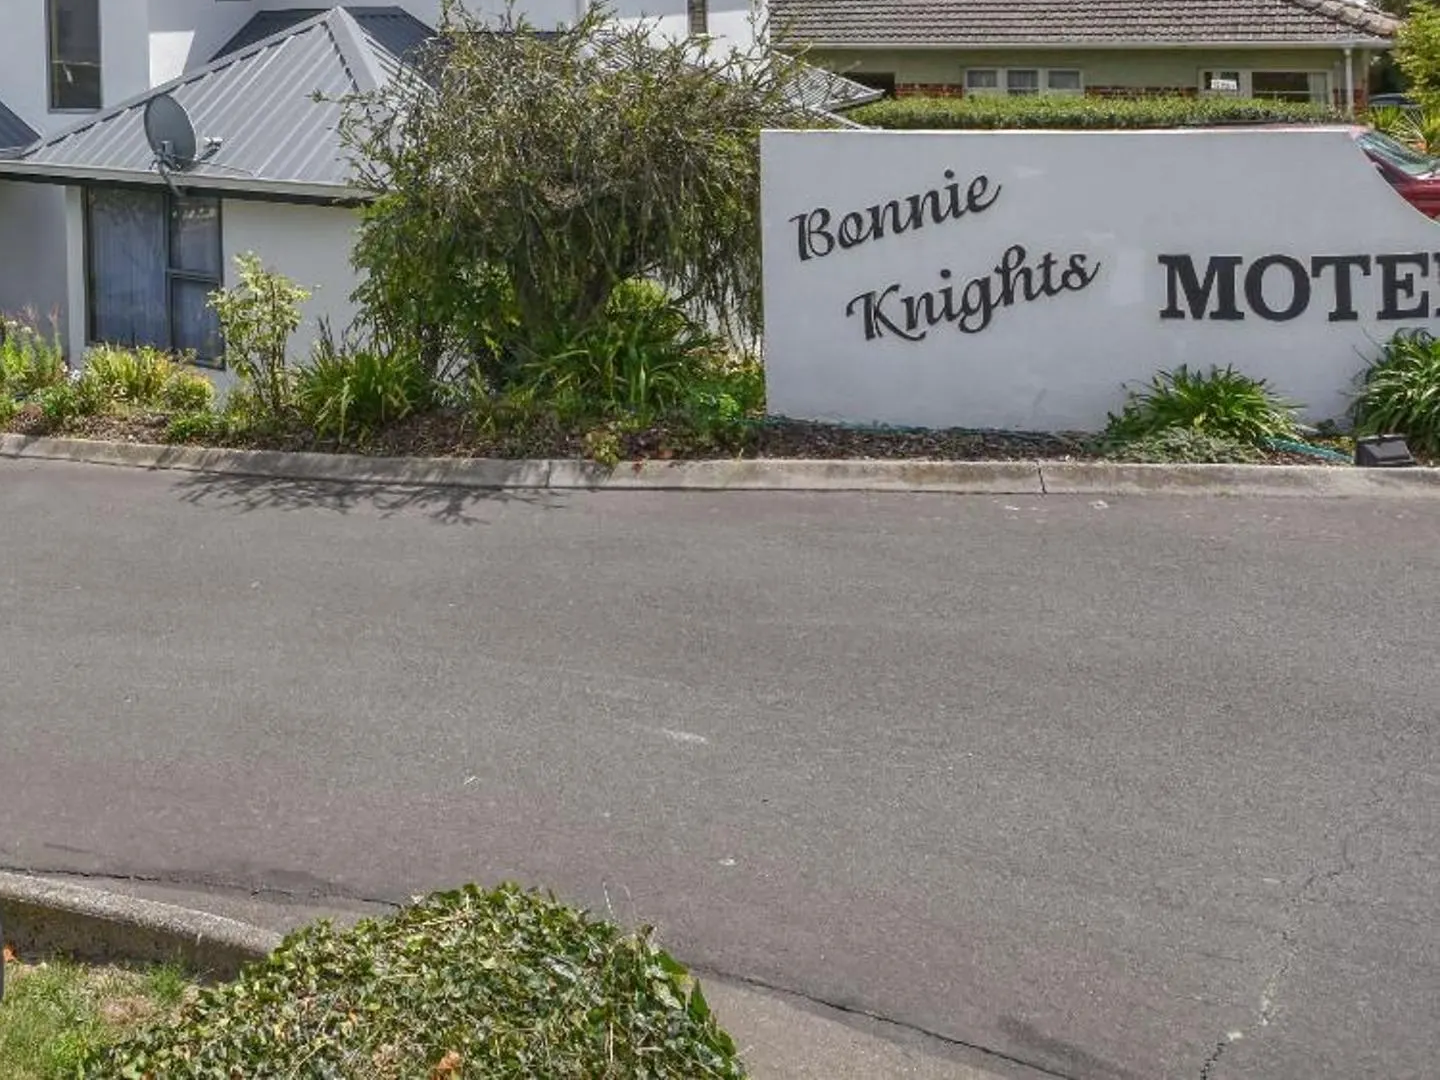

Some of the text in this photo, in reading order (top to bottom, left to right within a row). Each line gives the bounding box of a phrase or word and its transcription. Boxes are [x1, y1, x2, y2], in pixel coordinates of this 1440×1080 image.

[788, 169, 1003, 262] Bonnie
[846, 244, 1101, 341] Knights
[1157, 252, 1440, 322] MOTE
